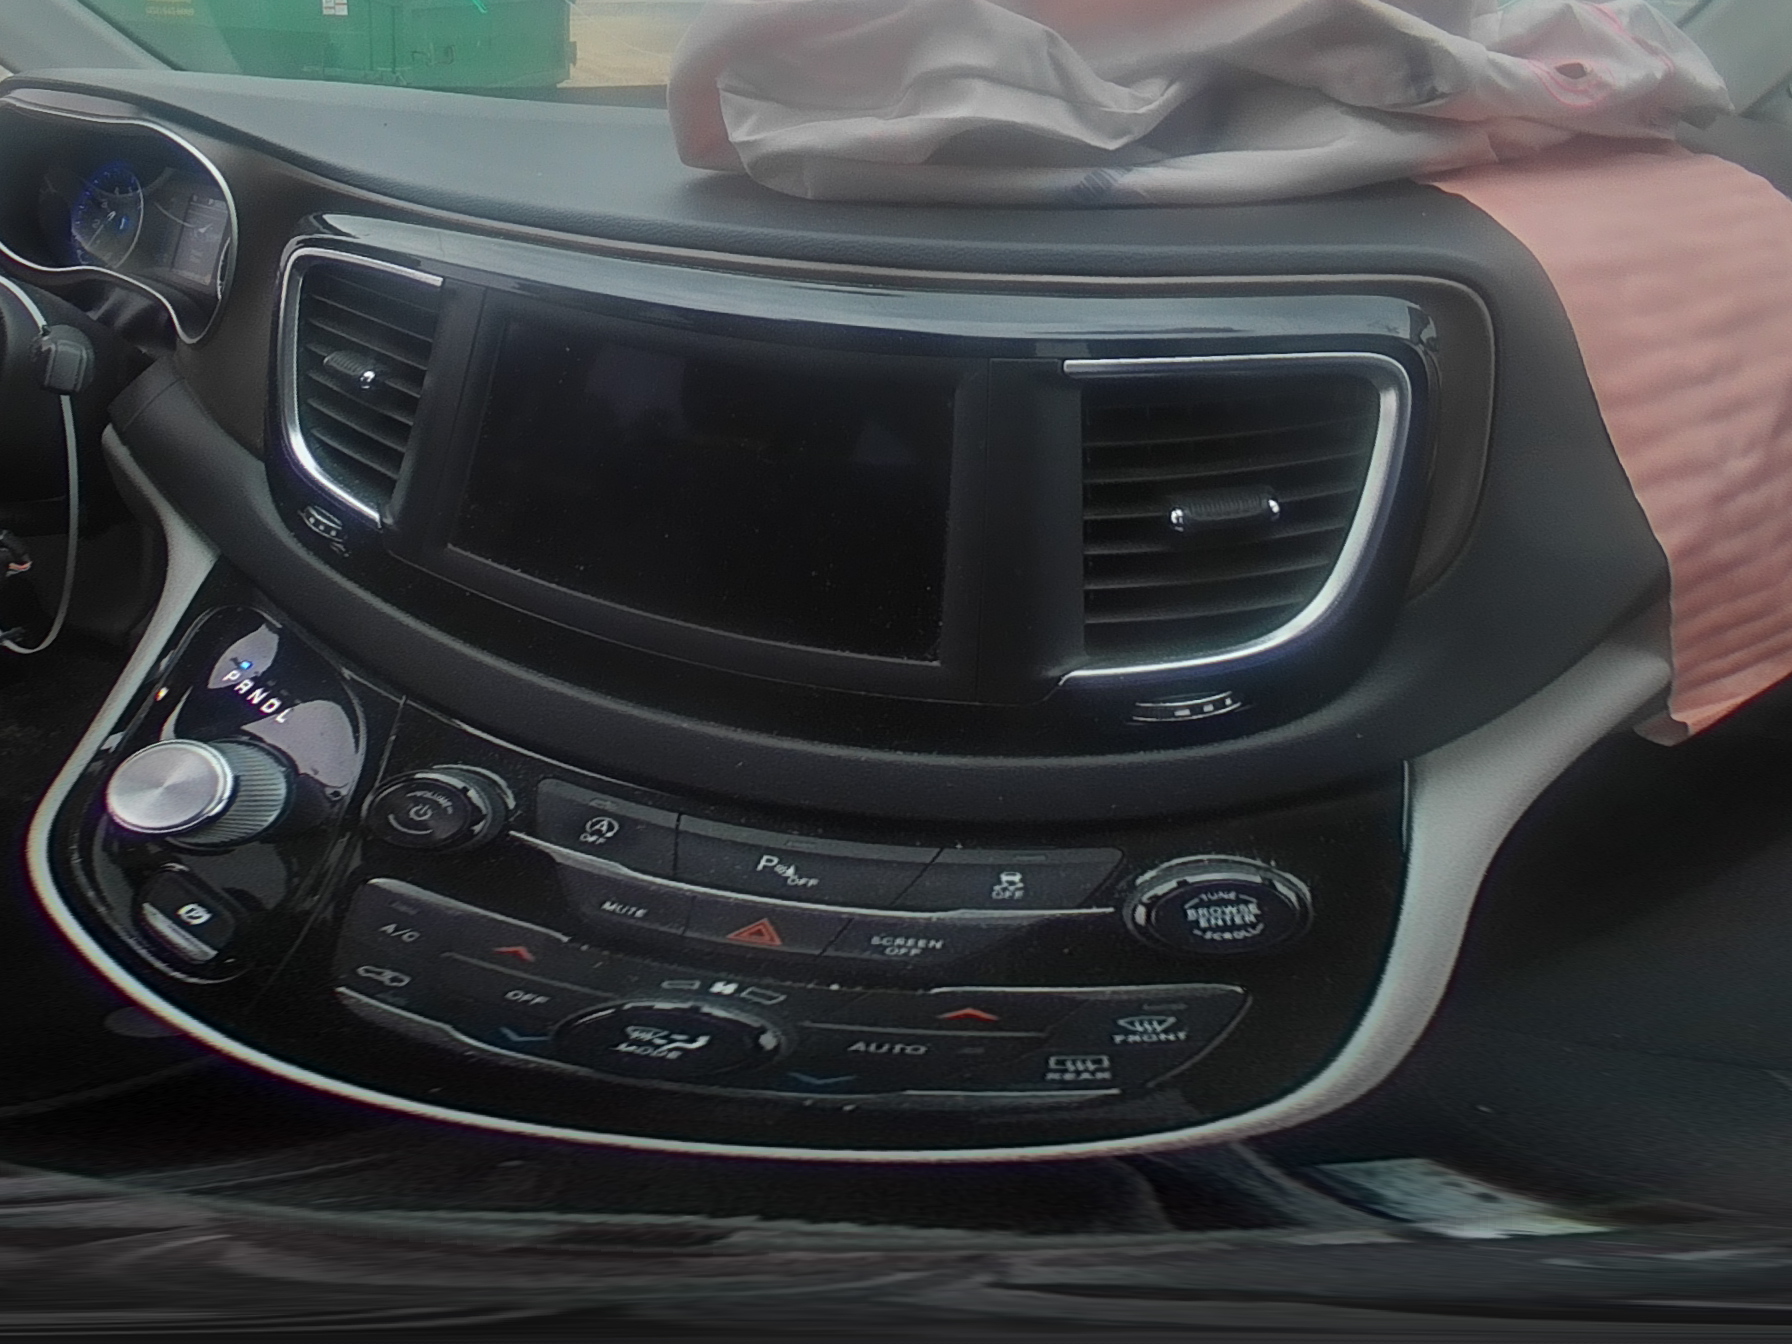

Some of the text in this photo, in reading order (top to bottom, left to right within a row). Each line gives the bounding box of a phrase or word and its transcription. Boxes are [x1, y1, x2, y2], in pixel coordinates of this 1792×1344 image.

[787, 874, 820, 888] OFF
[991, 889, 1024, 900] OFF
[601, 900, 648, 918] MUTE
[1186, 902, 1261, 922] BROWSE
[1198, 913, 1258, 929] ENTER
[379, 923, 421, 943] A/C
[870, 935, 944, 950] SCREEN
[884, 946, 923, 957] OFF
[504, 989, 551, 1005] OFF
[1112, 1031, 1188, 1044] FRONT
[847, 1040, 929, 1055] AUTO
[1045, 1071, 1112, 1081] REAR
